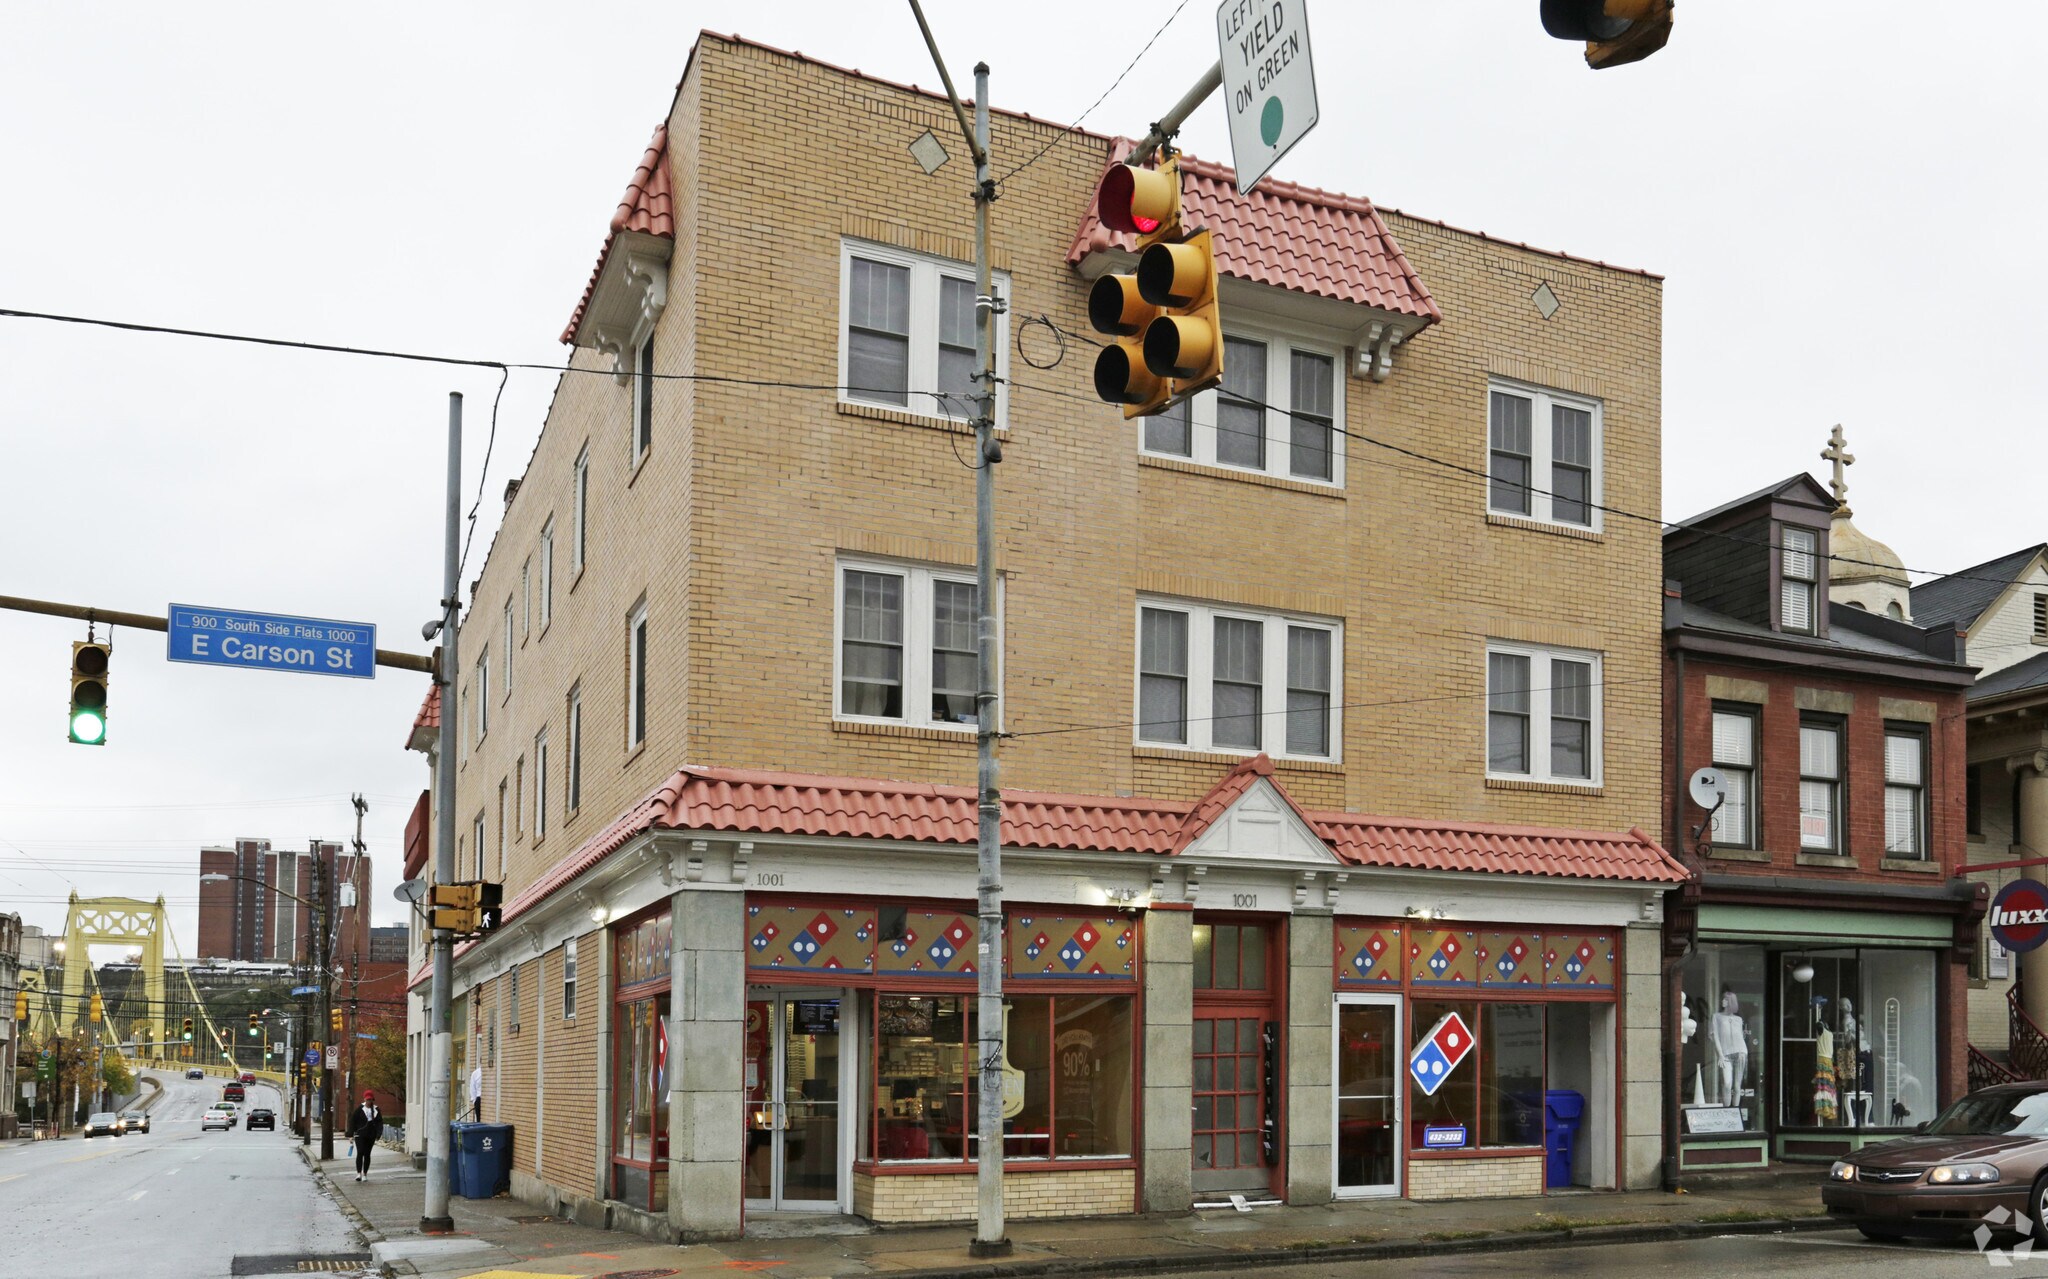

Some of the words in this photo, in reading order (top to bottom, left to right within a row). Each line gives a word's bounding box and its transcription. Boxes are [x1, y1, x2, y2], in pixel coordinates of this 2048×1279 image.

[1240, 1, 1284, 67] YIELD
[1236, 80, 1253, 114] ON
[1257, 30, 1299, 91] GREEN
[192, 615, 217, 628] 900
[225, 619, 260, 633] South
[264, 622, 290, 636] Side
[294, 626, 323, 639] Flats
[327, 629, 356, 642] 1000
[192, 634, 209, 656] E
[221, 636, 315, 666] Carson
[326, 647, 353, 669] St
[757, 872, 785, 887] 1001
[1233, 893, 1257, 908] 1001
[1990, 905, 2048, 927] luxx
[1063, 1051, 1091, 1077] 90%
